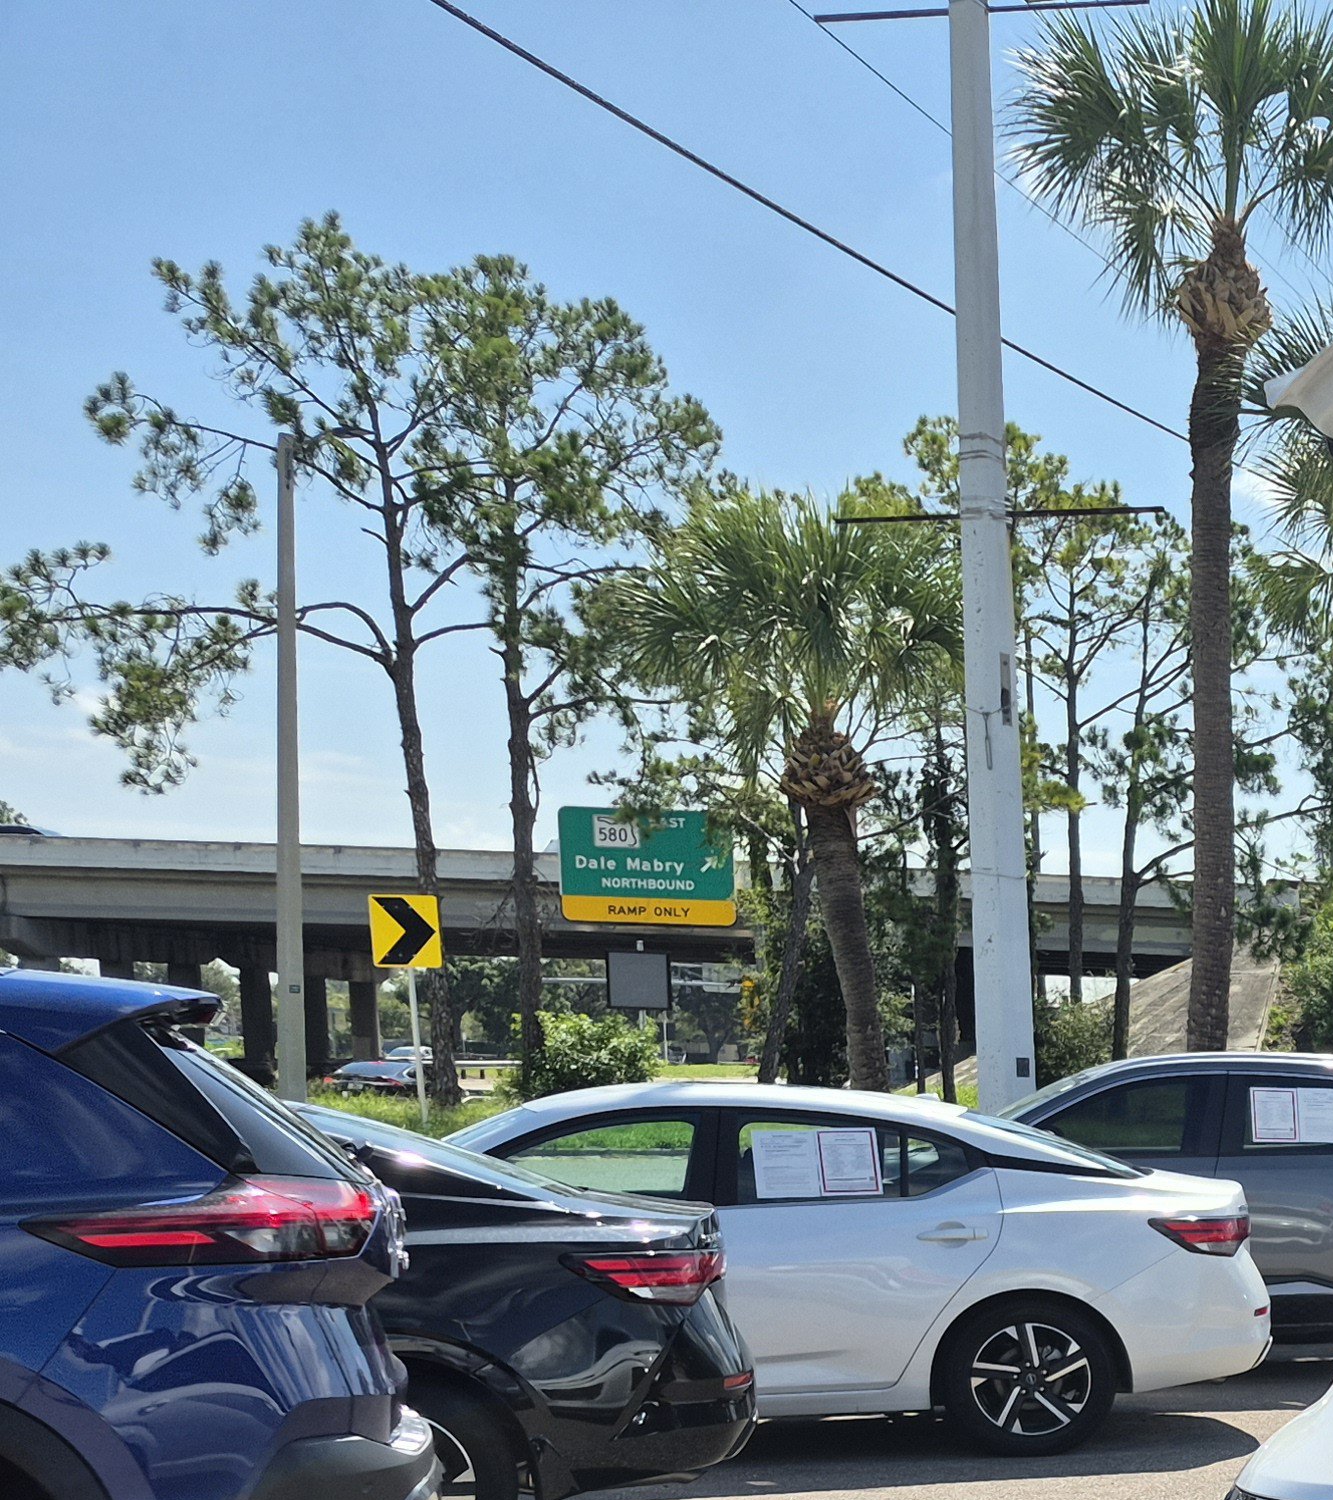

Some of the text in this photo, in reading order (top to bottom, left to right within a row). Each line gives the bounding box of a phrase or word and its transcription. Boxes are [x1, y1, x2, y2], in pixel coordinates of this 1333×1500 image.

[598, 827, 628, 843] 580
[575, 855, 685, 875] Dale Mabry
[601, 877, 695, 891] NORTHBOUND
[607, 905, 690, 917] RAMP ONLY
